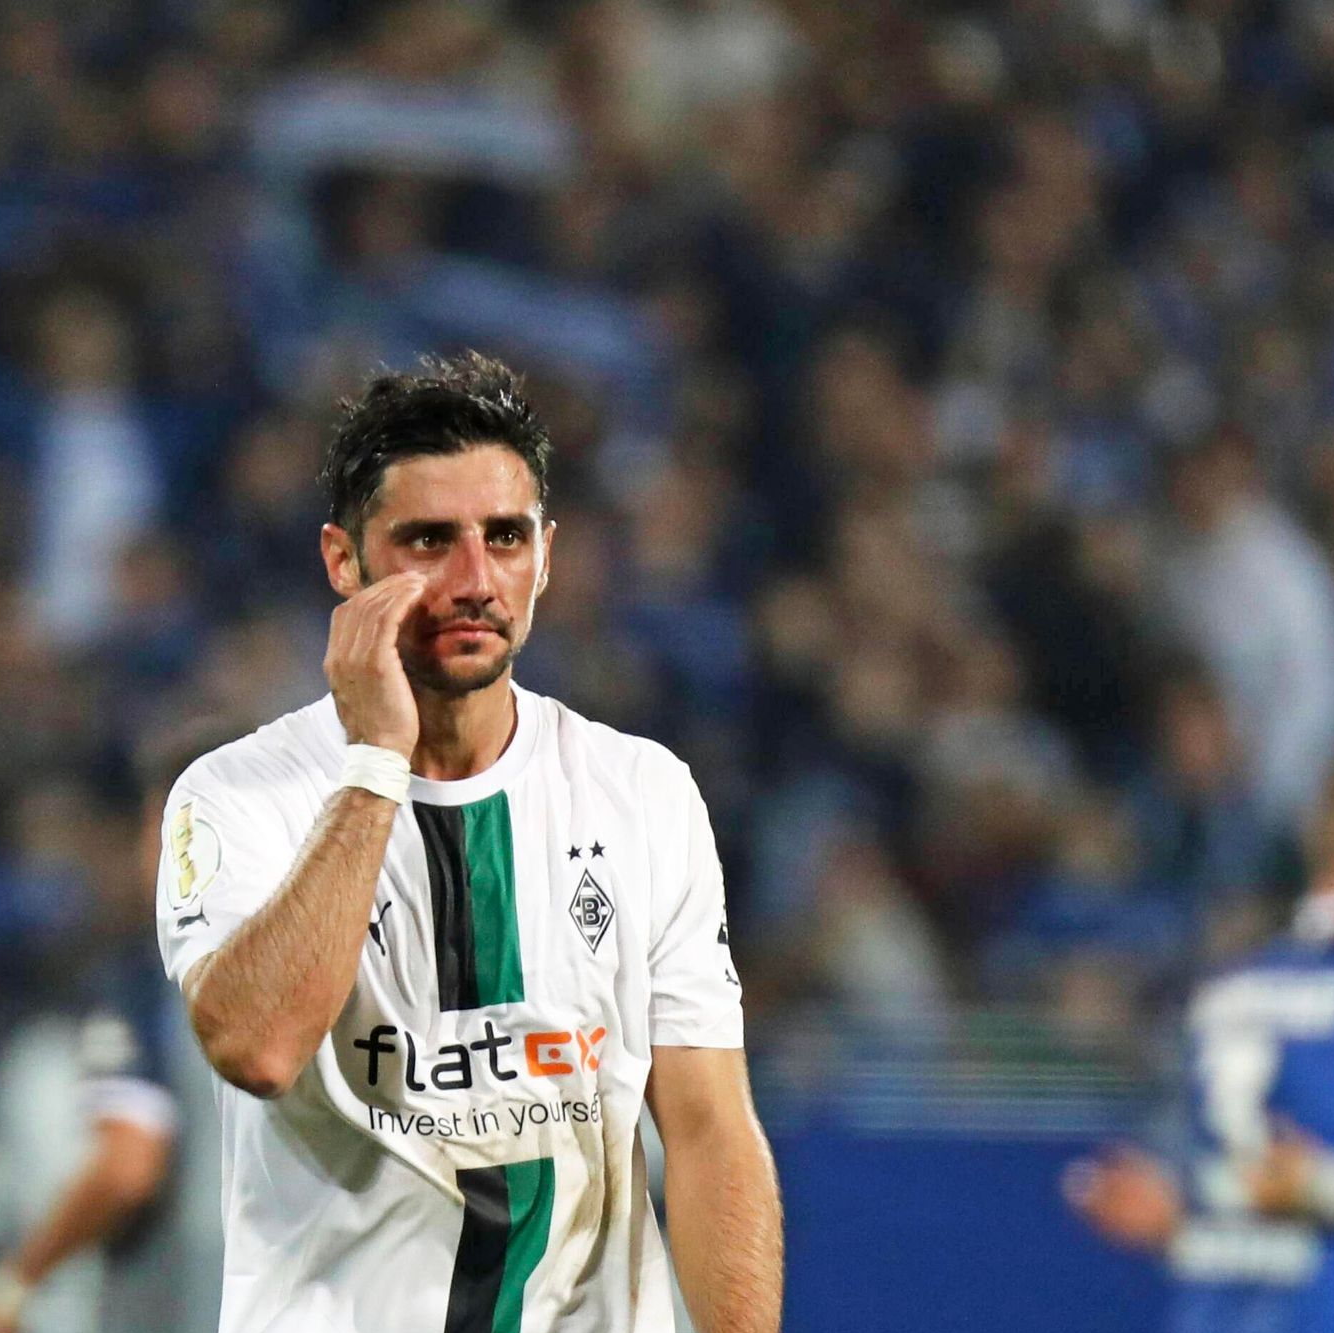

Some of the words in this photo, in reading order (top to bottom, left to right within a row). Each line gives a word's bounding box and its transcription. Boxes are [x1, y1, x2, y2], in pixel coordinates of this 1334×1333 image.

[580, 895, 603, 928] B
[368, 1104, 462, 1137] Invest
[472, 1107, 500, 1136] in
[508, 1092, 600, 1135] yourse
